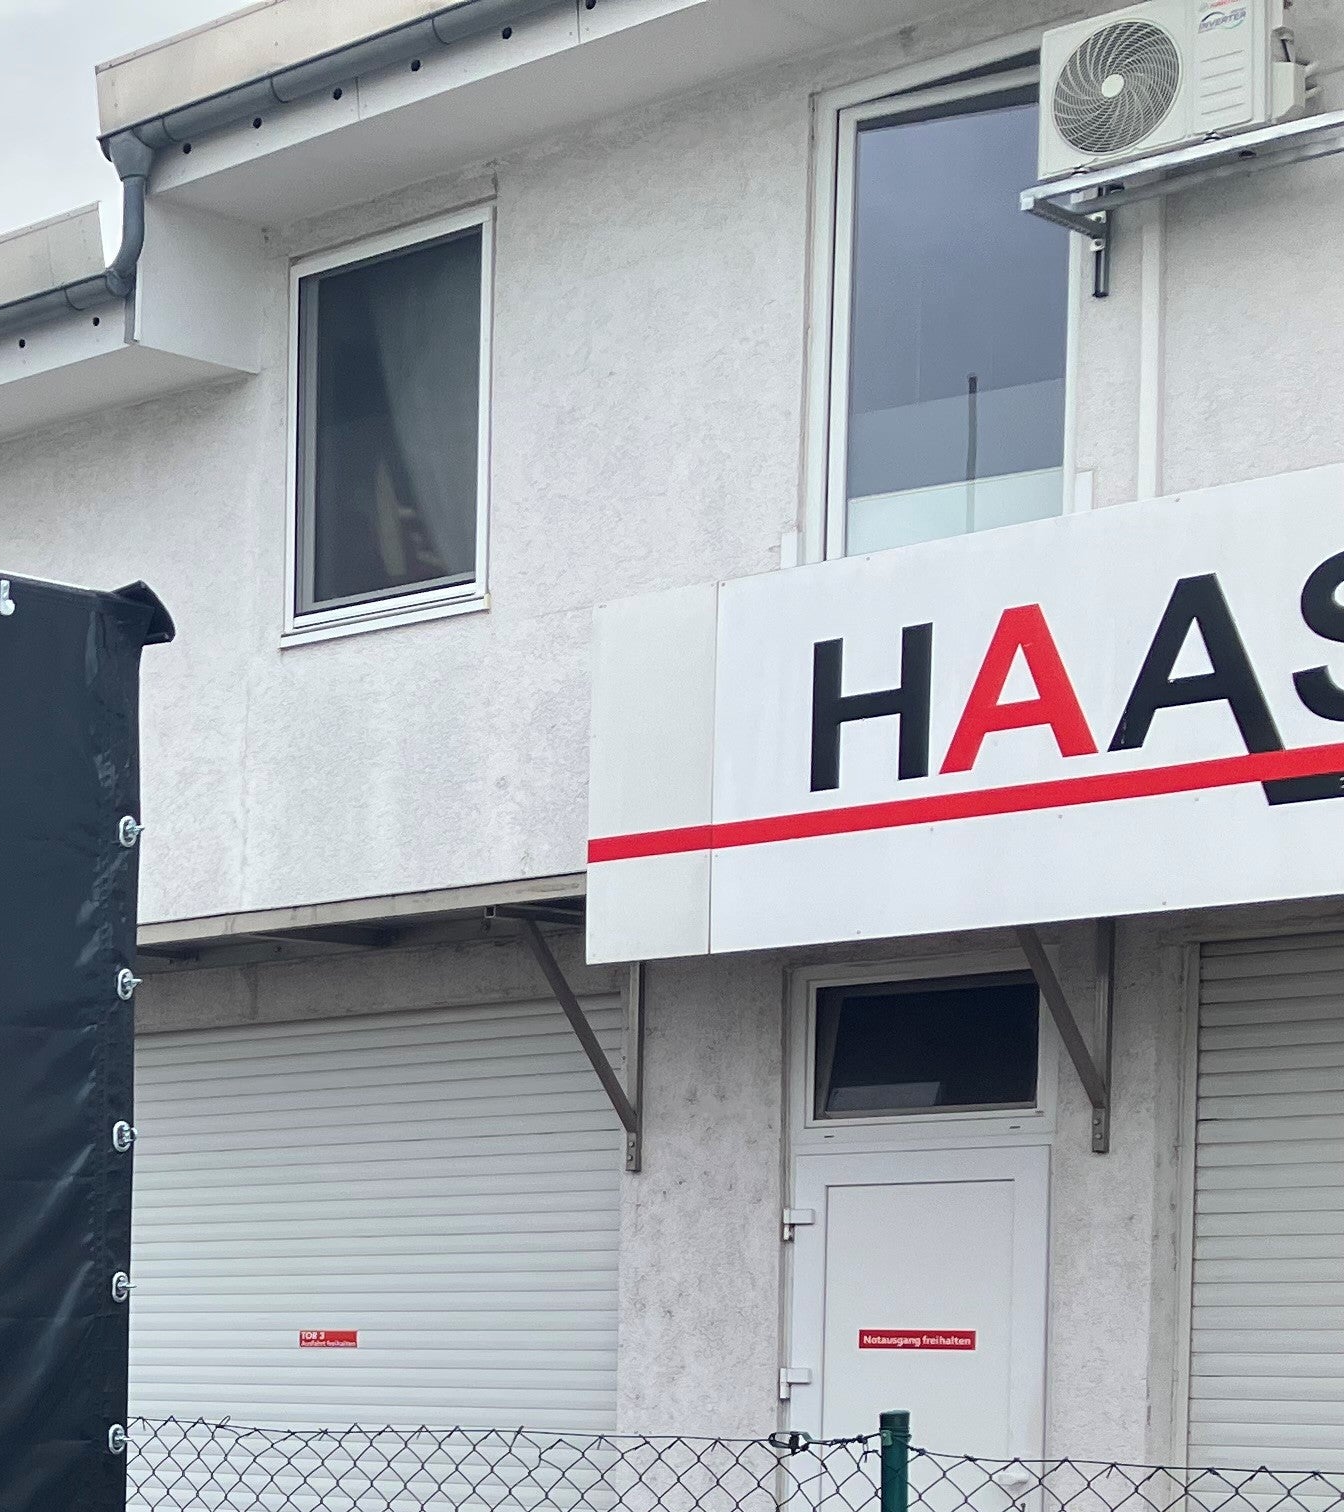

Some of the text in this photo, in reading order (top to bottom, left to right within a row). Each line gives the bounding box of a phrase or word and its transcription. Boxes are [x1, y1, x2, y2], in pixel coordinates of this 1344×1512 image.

[300, 1331, 325, 1340] TOR 3
[863, 1334, 971, 1347] Notausgang freihalten
